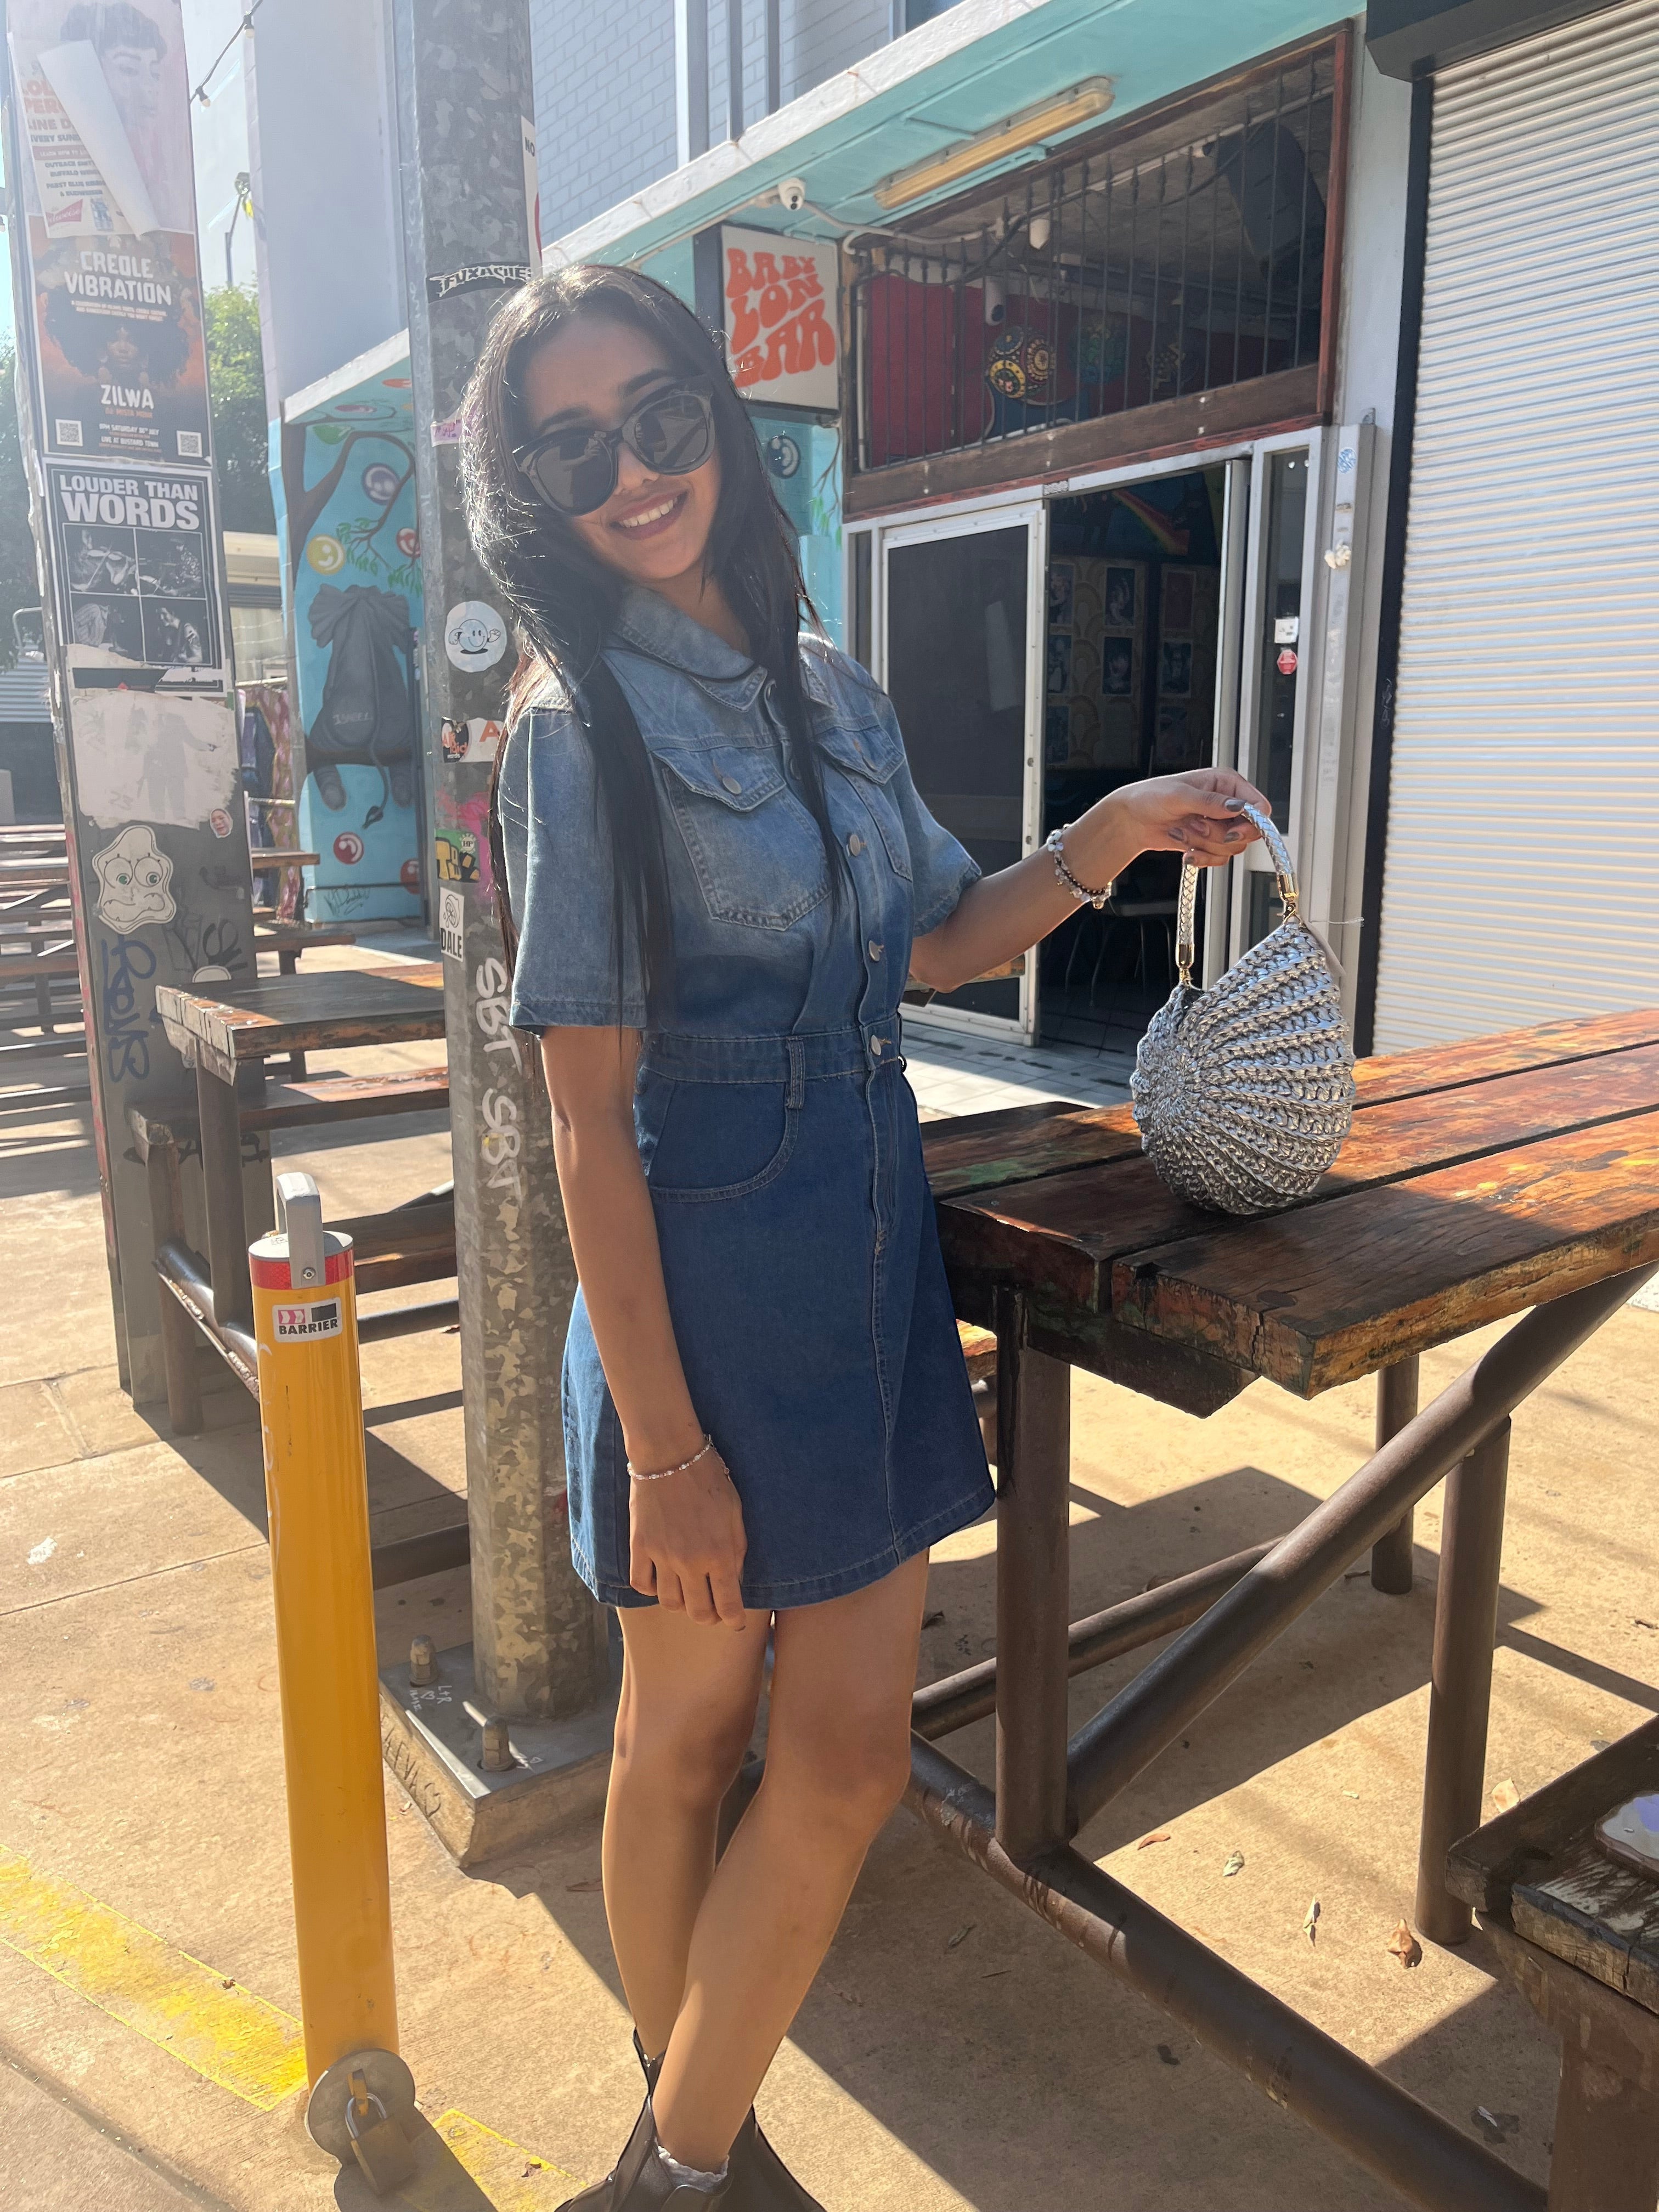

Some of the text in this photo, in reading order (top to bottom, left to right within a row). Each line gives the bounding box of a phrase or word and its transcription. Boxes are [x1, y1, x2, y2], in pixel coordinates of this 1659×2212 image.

[80, 251, 154, 279] CREOLE
[64, 271, 172, 306] VIBRATION
[733, 298, 836, 388] BAR
[100, 385, 155, 410] ZILWA
[59, 474, 198, 501] LOUDER THAN
[60, 492, 200, 530] WORDS
[440, 927, 462, 958] DALE
[278, 1318, 338, 1335] BARRIER
